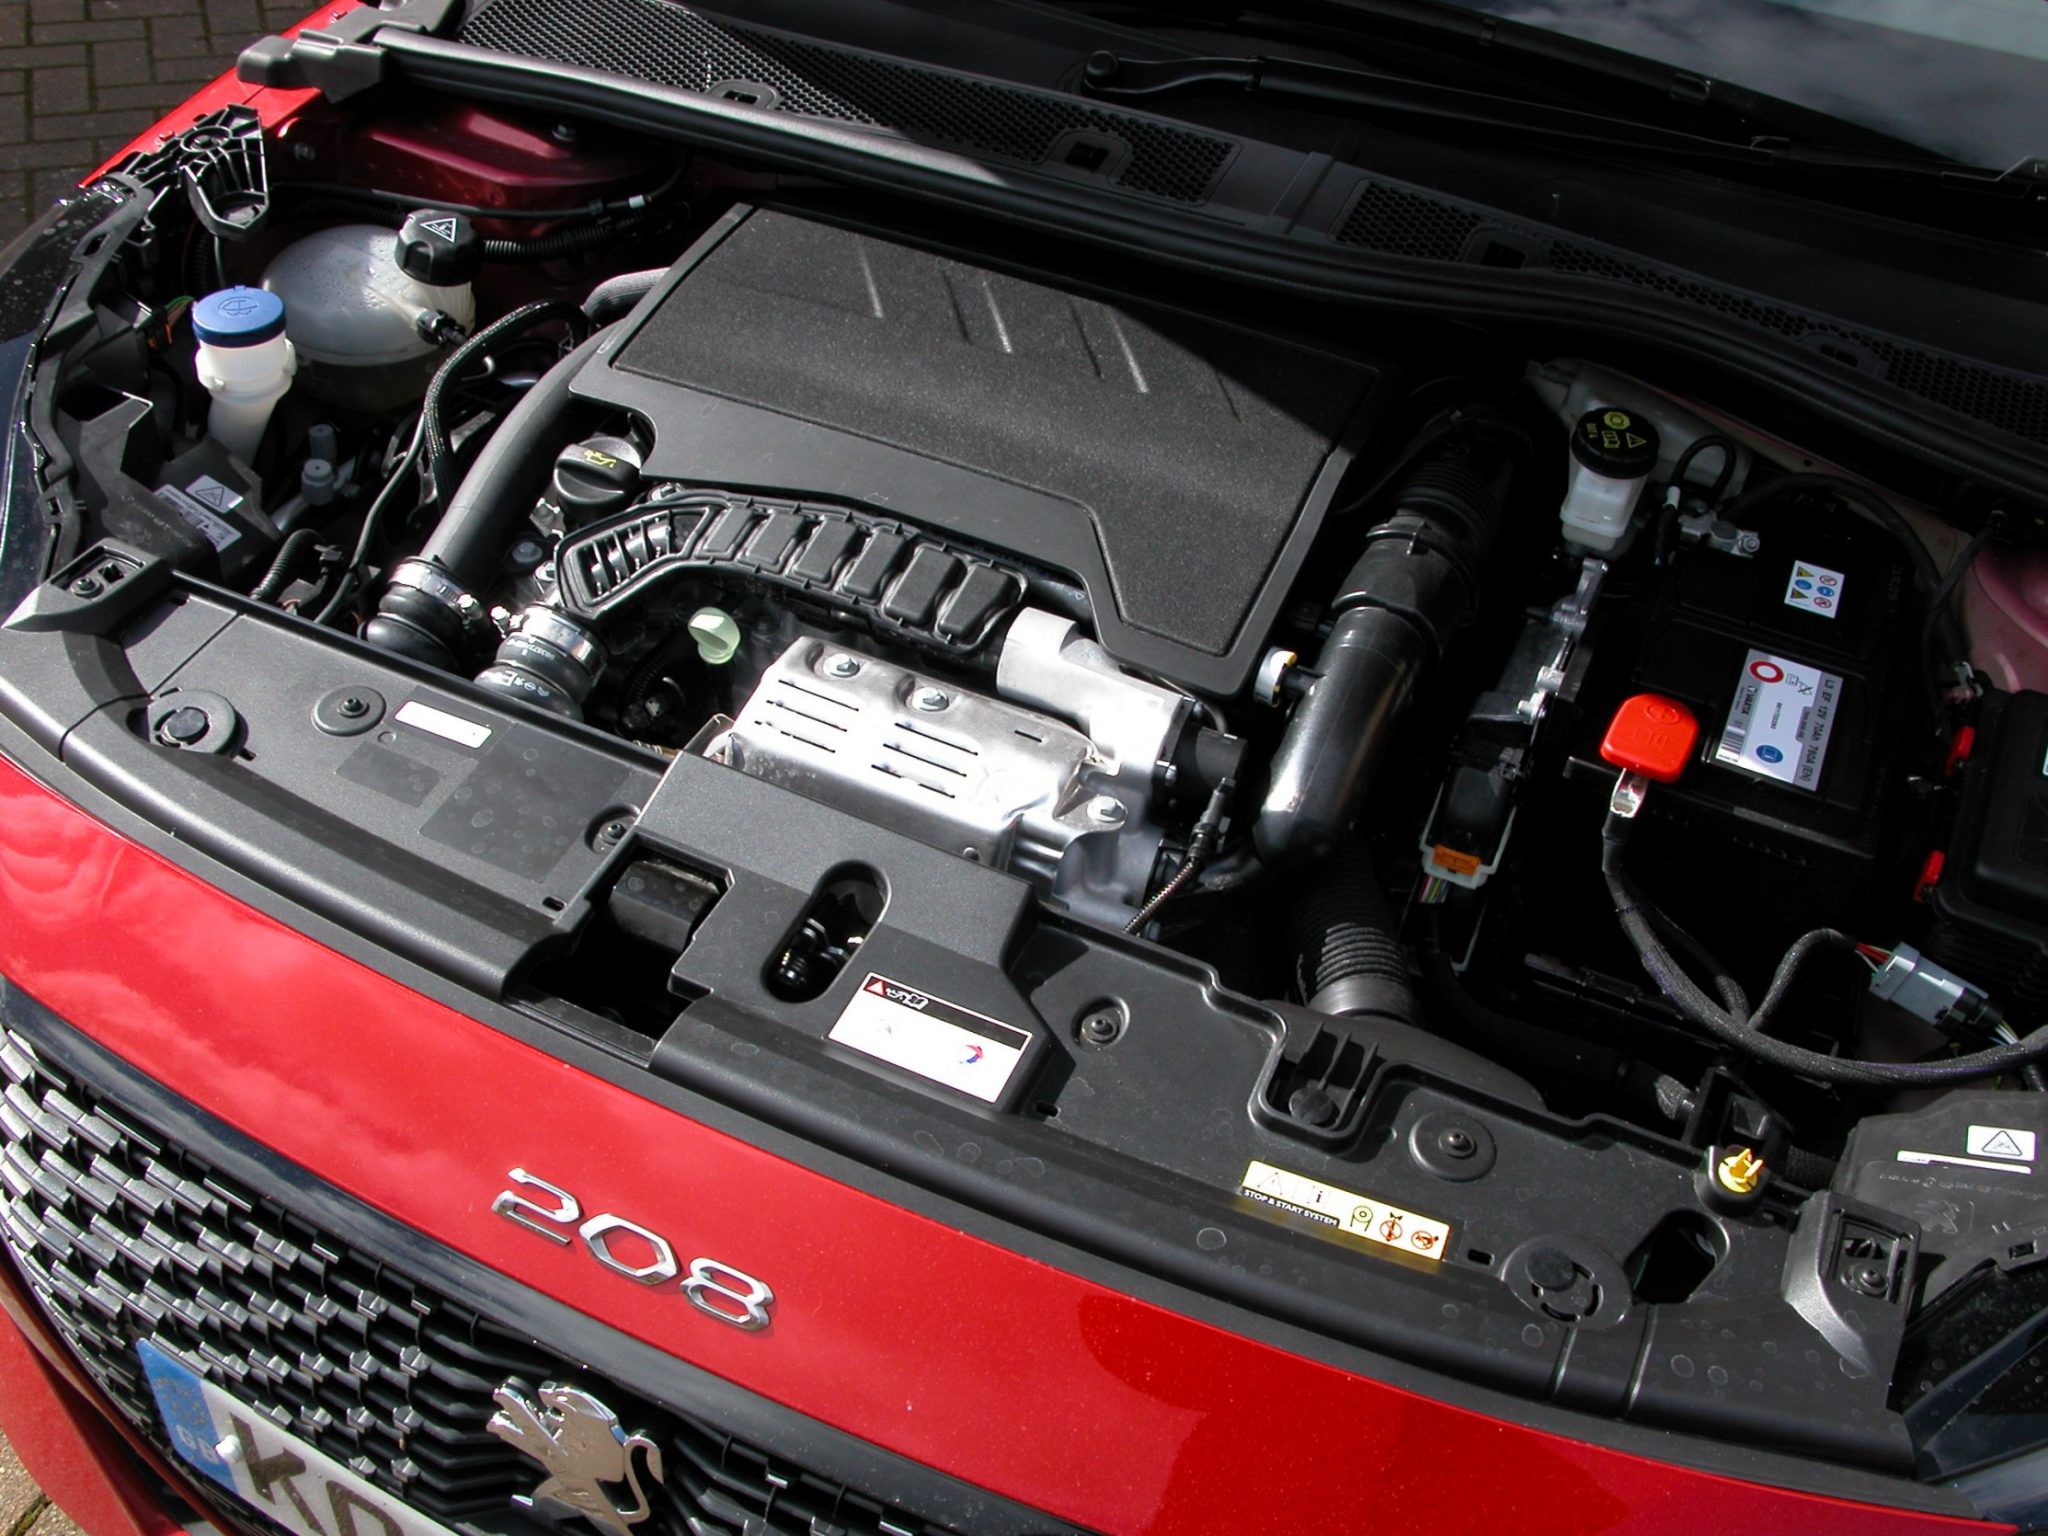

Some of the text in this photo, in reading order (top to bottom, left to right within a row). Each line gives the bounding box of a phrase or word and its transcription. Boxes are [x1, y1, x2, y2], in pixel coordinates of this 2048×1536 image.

[1741, 694, 1755, 714] VARTA
[1817, 705, 1828, 721] 12V
[1244, 1189, 1268, 1202] STOP
[1275, 1200, 1304, 1214] START
[1303, 1209, 1337, 1226] SYSTEM
[491, 1167, 775, 1332] 208
